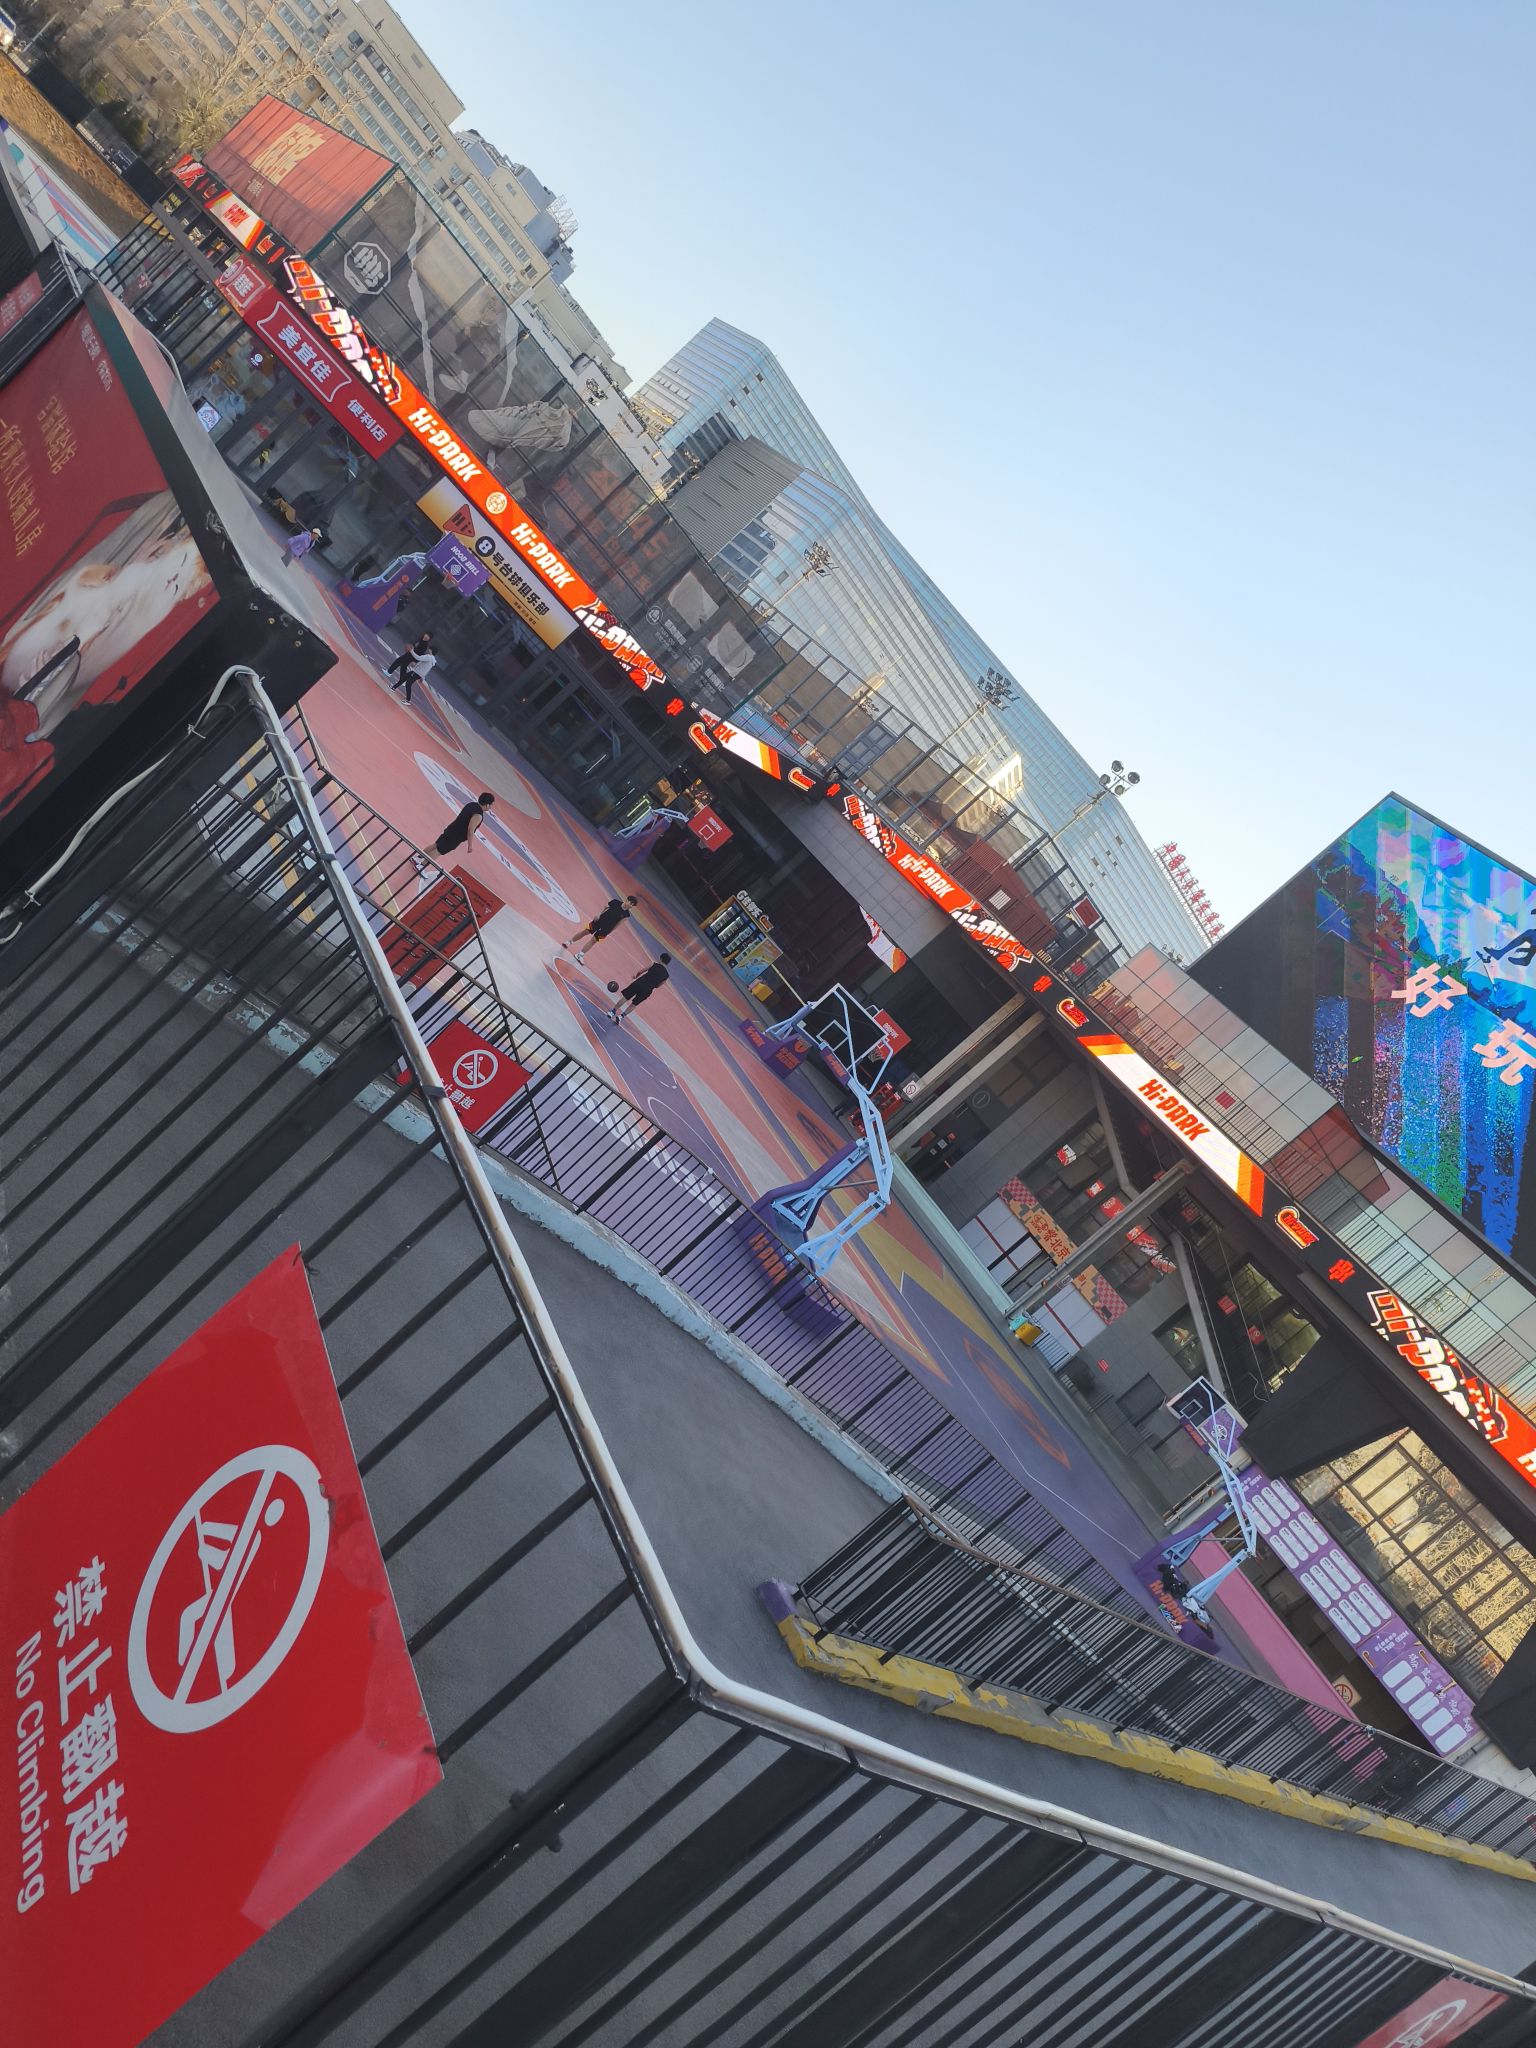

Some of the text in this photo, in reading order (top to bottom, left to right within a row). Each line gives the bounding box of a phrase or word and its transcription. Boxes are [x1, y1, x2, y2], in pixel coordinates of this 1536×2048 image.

[278, 324, 332, 383] 美宜佳
[347, 399, 388, 442] 便利店
[408, 407, 482, 482] Hi-PARK
[477, 538, 551, 616] 8号台球俱乐部
[510, 522, 575, 589] Hi-PARK
[1391, 961, 1536, 1087] 好 玩
[1138, 1078, 1210, 1143] Hi-PARK
[51, 1554, 128, 1895] 禁止翻越
[14, 1630, 48, 1914] No Climbing
